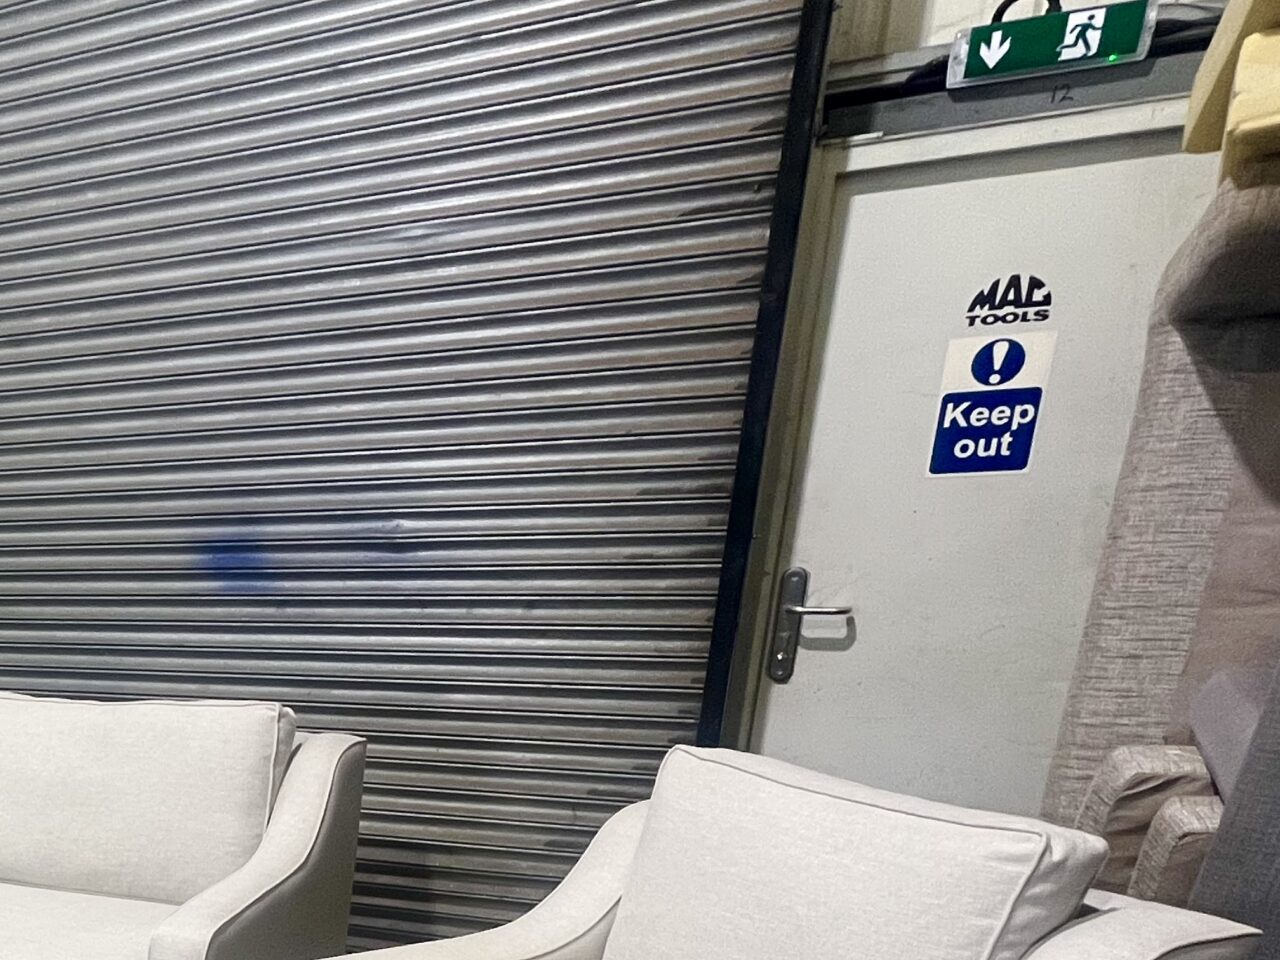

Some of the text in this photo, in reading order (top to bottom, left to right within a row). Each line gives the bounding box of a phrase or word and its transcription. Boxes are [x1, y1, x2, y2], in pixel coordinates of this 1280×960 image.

[1050, 83, 1075, 104] 12
[966, 273, 1052, 313] MAC
[965, 309, 1051, 327] TOOLS
[943, 401, 1036, 431] Keep
[953, 431, 1014, 459] out
